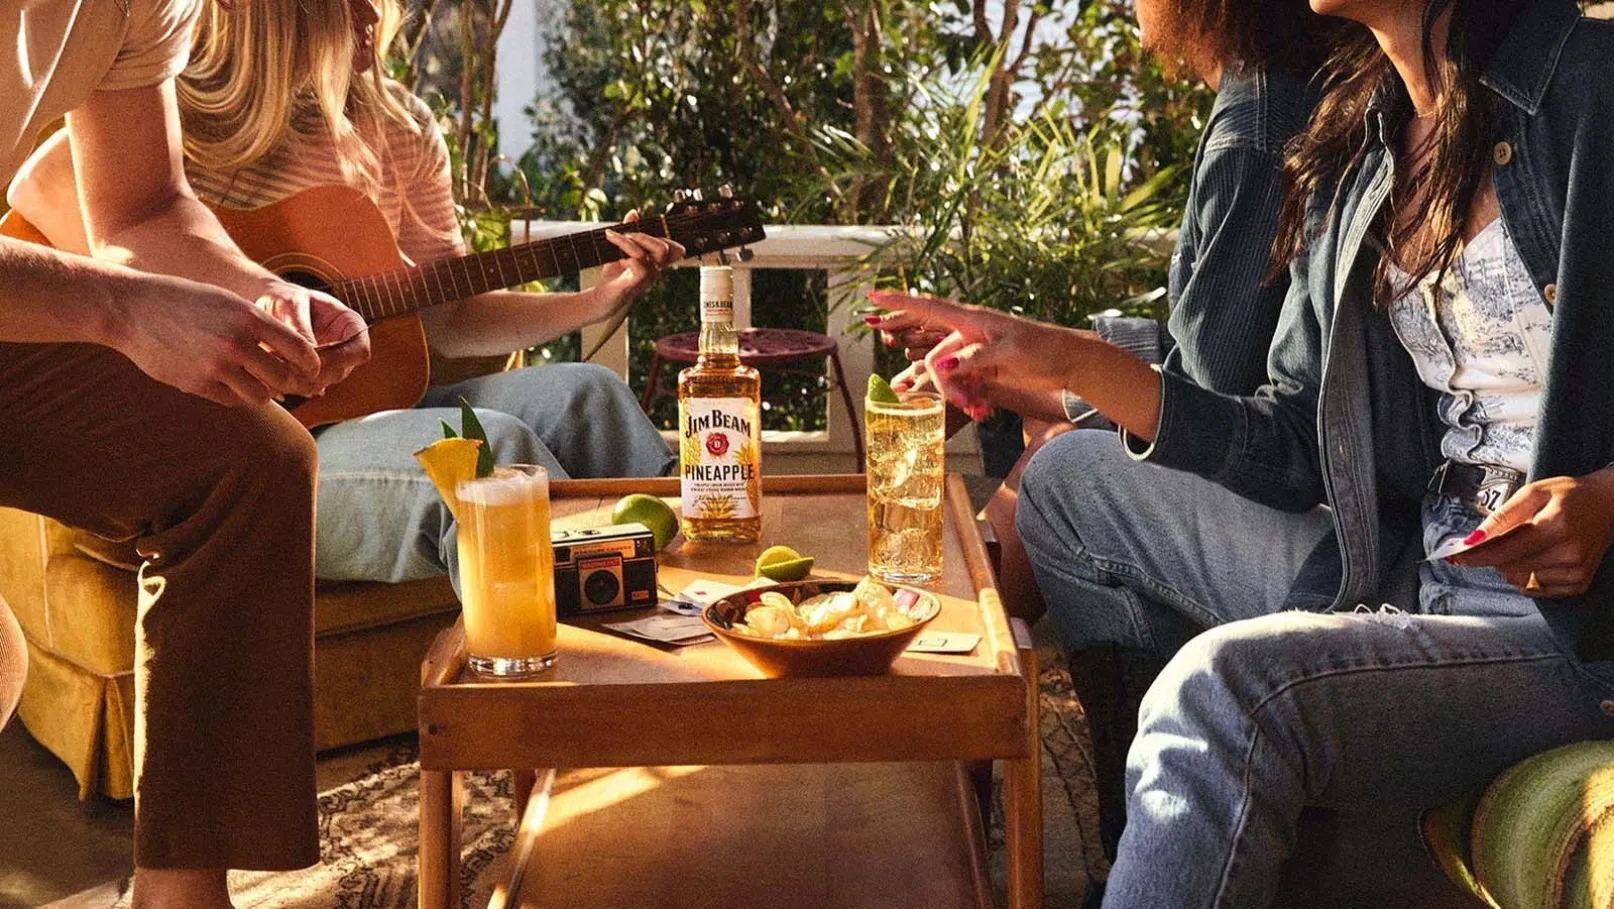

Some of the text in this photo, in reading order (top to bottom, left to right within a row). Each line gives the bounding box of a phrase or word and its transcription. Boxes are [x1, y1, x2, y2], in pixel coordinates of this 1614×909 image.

[685, 409, 751, 439] JIM BEAM
[685, 463, 755, 481] PINEAPPLE
